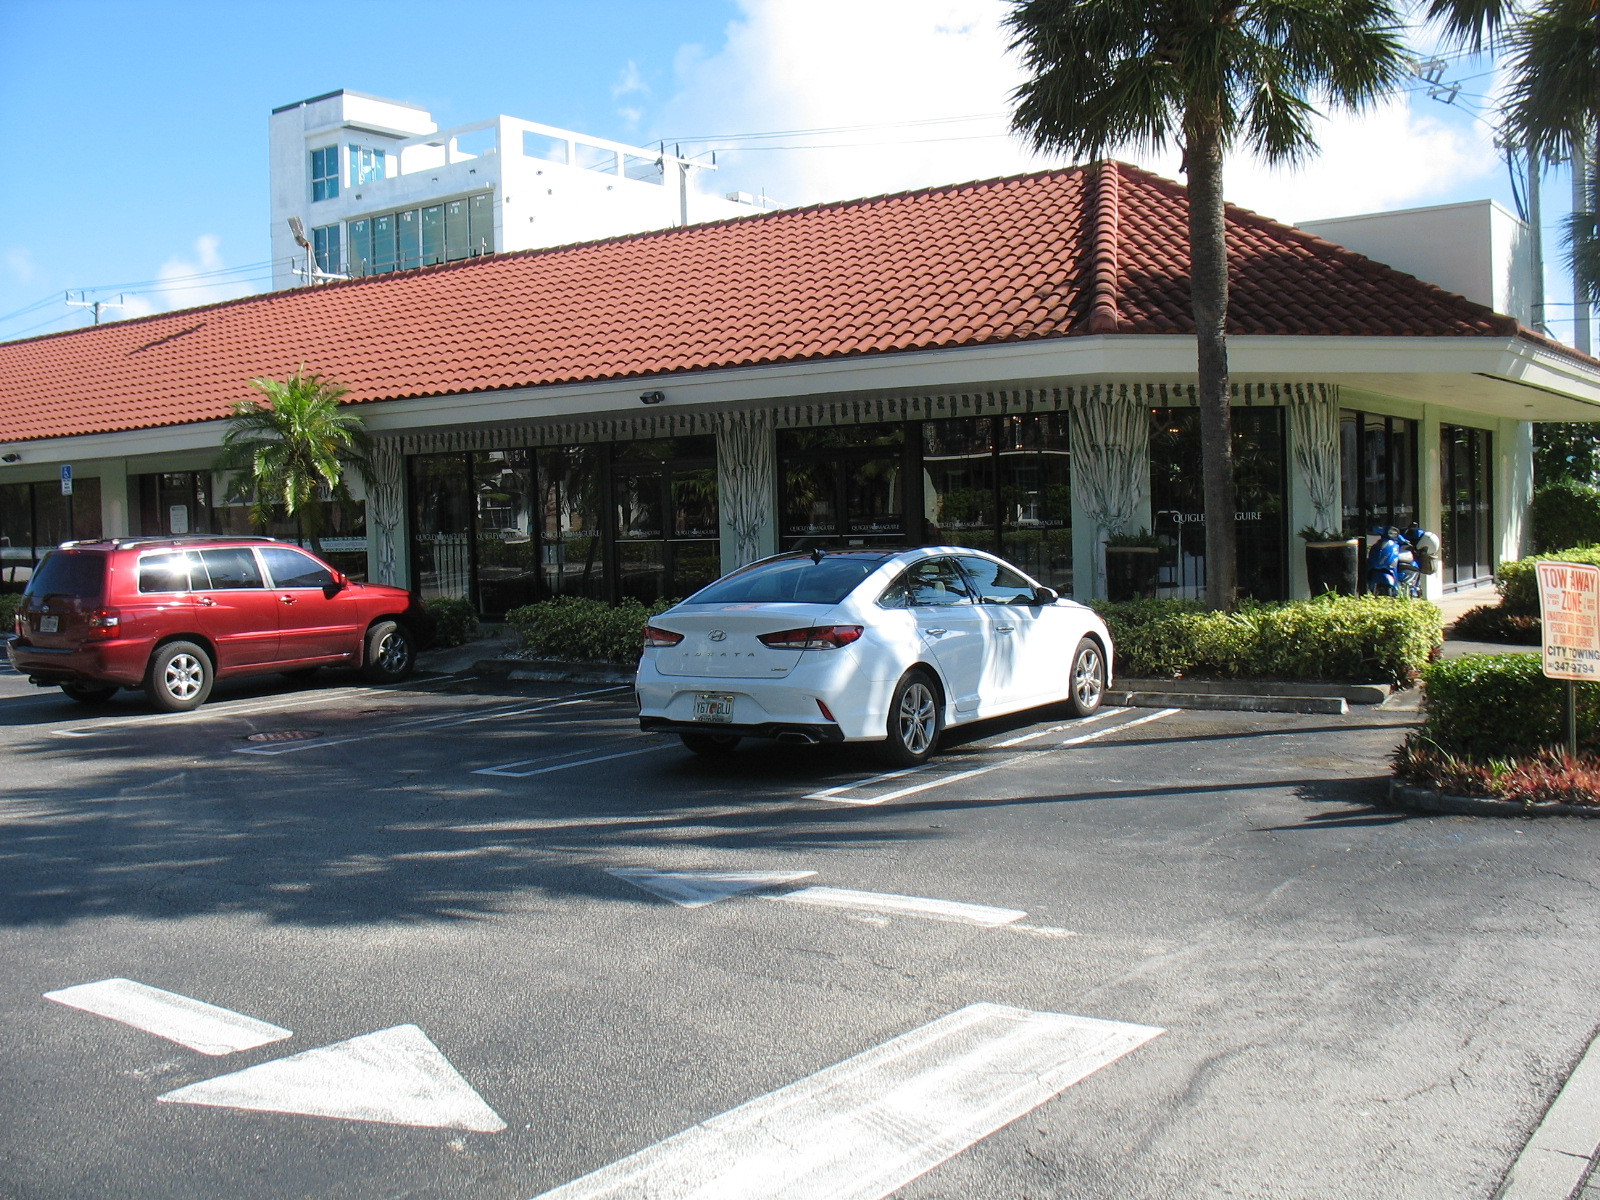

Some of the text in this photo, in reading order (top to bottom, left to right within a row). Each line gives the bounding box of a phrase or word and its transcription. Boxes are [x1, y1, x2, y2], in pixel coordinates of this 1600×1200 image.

[1172, 511, 1262, 524] QUIGLE GUIRE
[1541, 568, 1596, 593] TOW AWAY
[1561, 590, 1583, 613] ZONE
[1547, 645, 1600, 660] CITY TOWING
